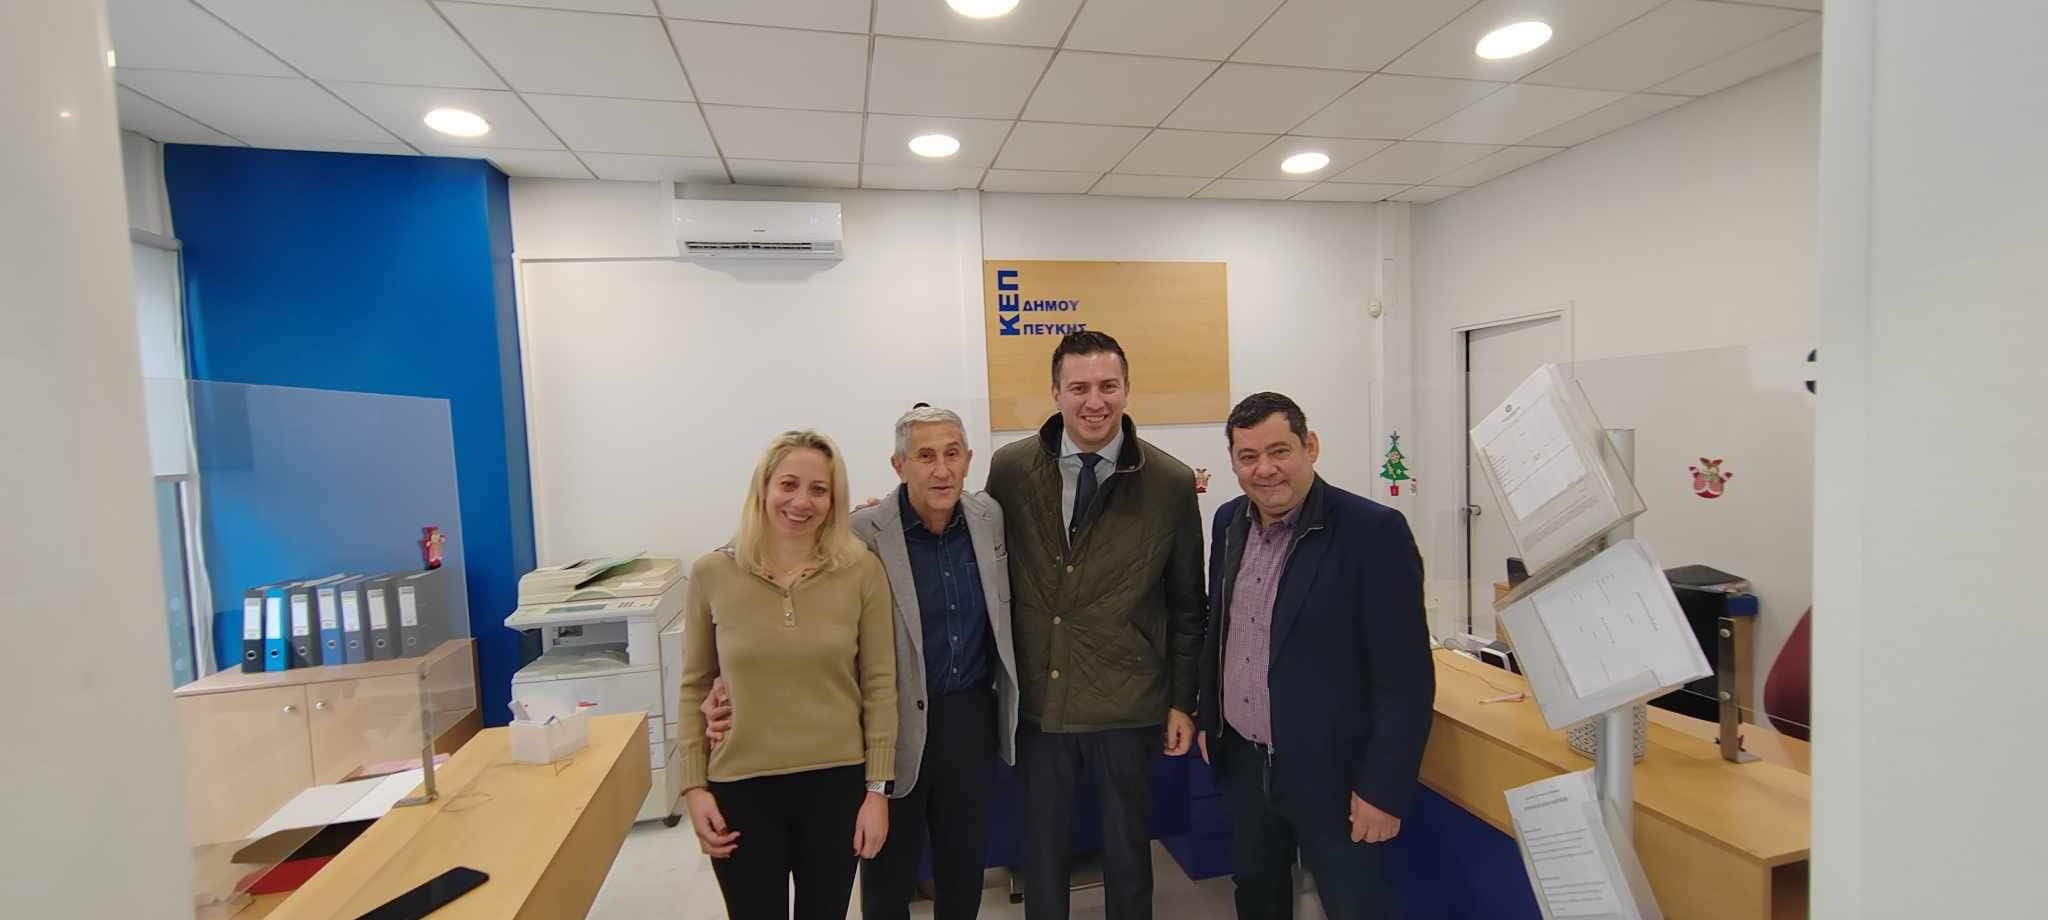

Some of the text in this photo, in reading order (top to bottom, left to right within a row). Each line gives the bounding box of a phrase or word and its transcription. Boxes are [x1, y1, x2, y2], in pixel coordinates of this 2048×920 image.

[997, 270, 1021, 336] ΚΕΠ
[1022, 300, 1080, 312] ΔΗΜΟΥ
[1023, 323, 1087, 336] ΠΕΥΚΗΣ
